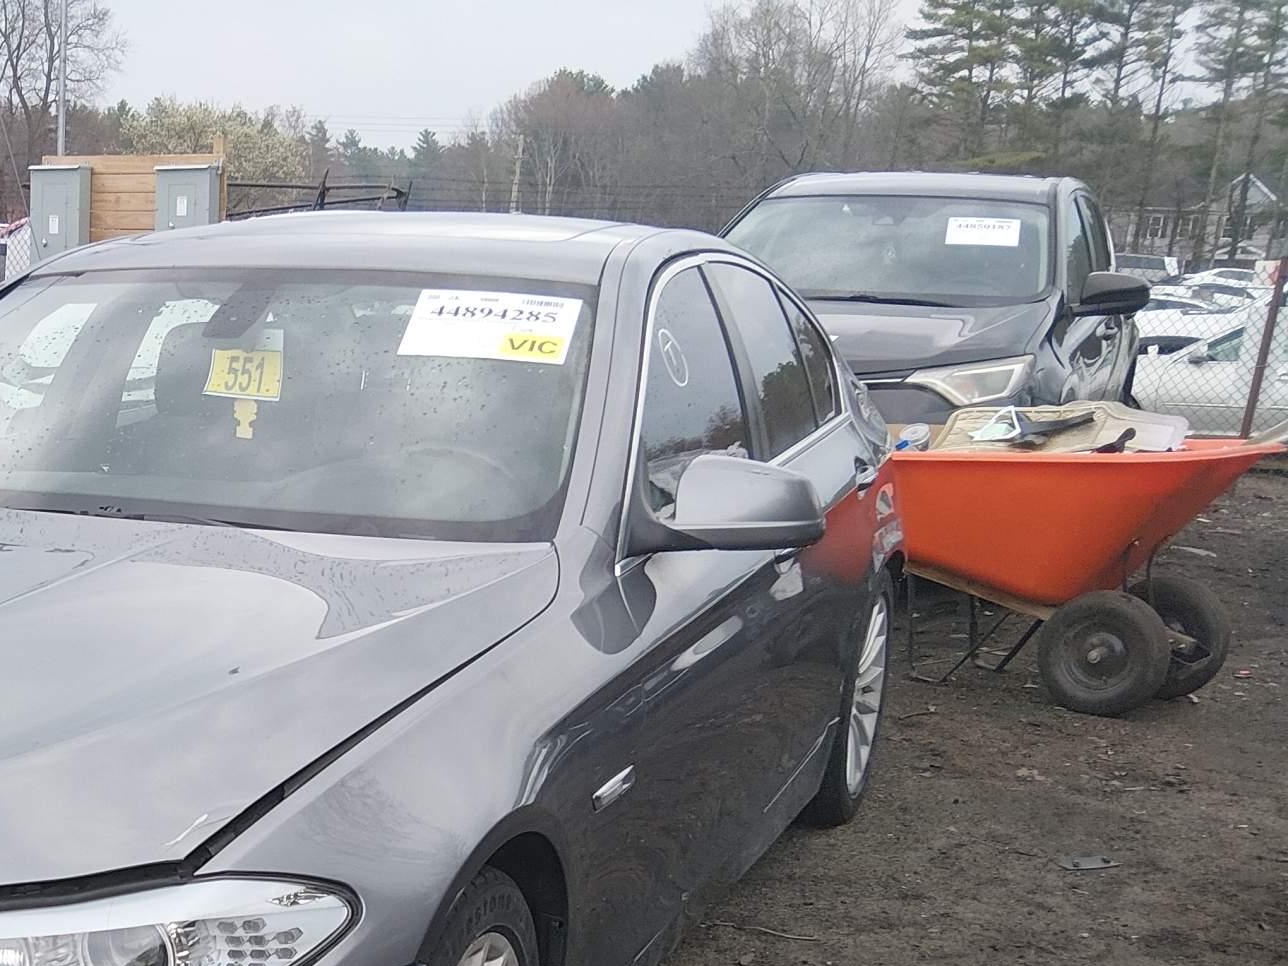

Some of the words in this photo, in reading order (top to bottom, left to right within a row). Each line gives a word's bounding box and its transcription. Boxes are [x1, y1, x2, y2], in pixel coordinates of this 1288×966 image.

[431, 304, 558, 323] 44894285
[509, 338, 558, 354] VIC
[224, 355, 265, 393] 551
